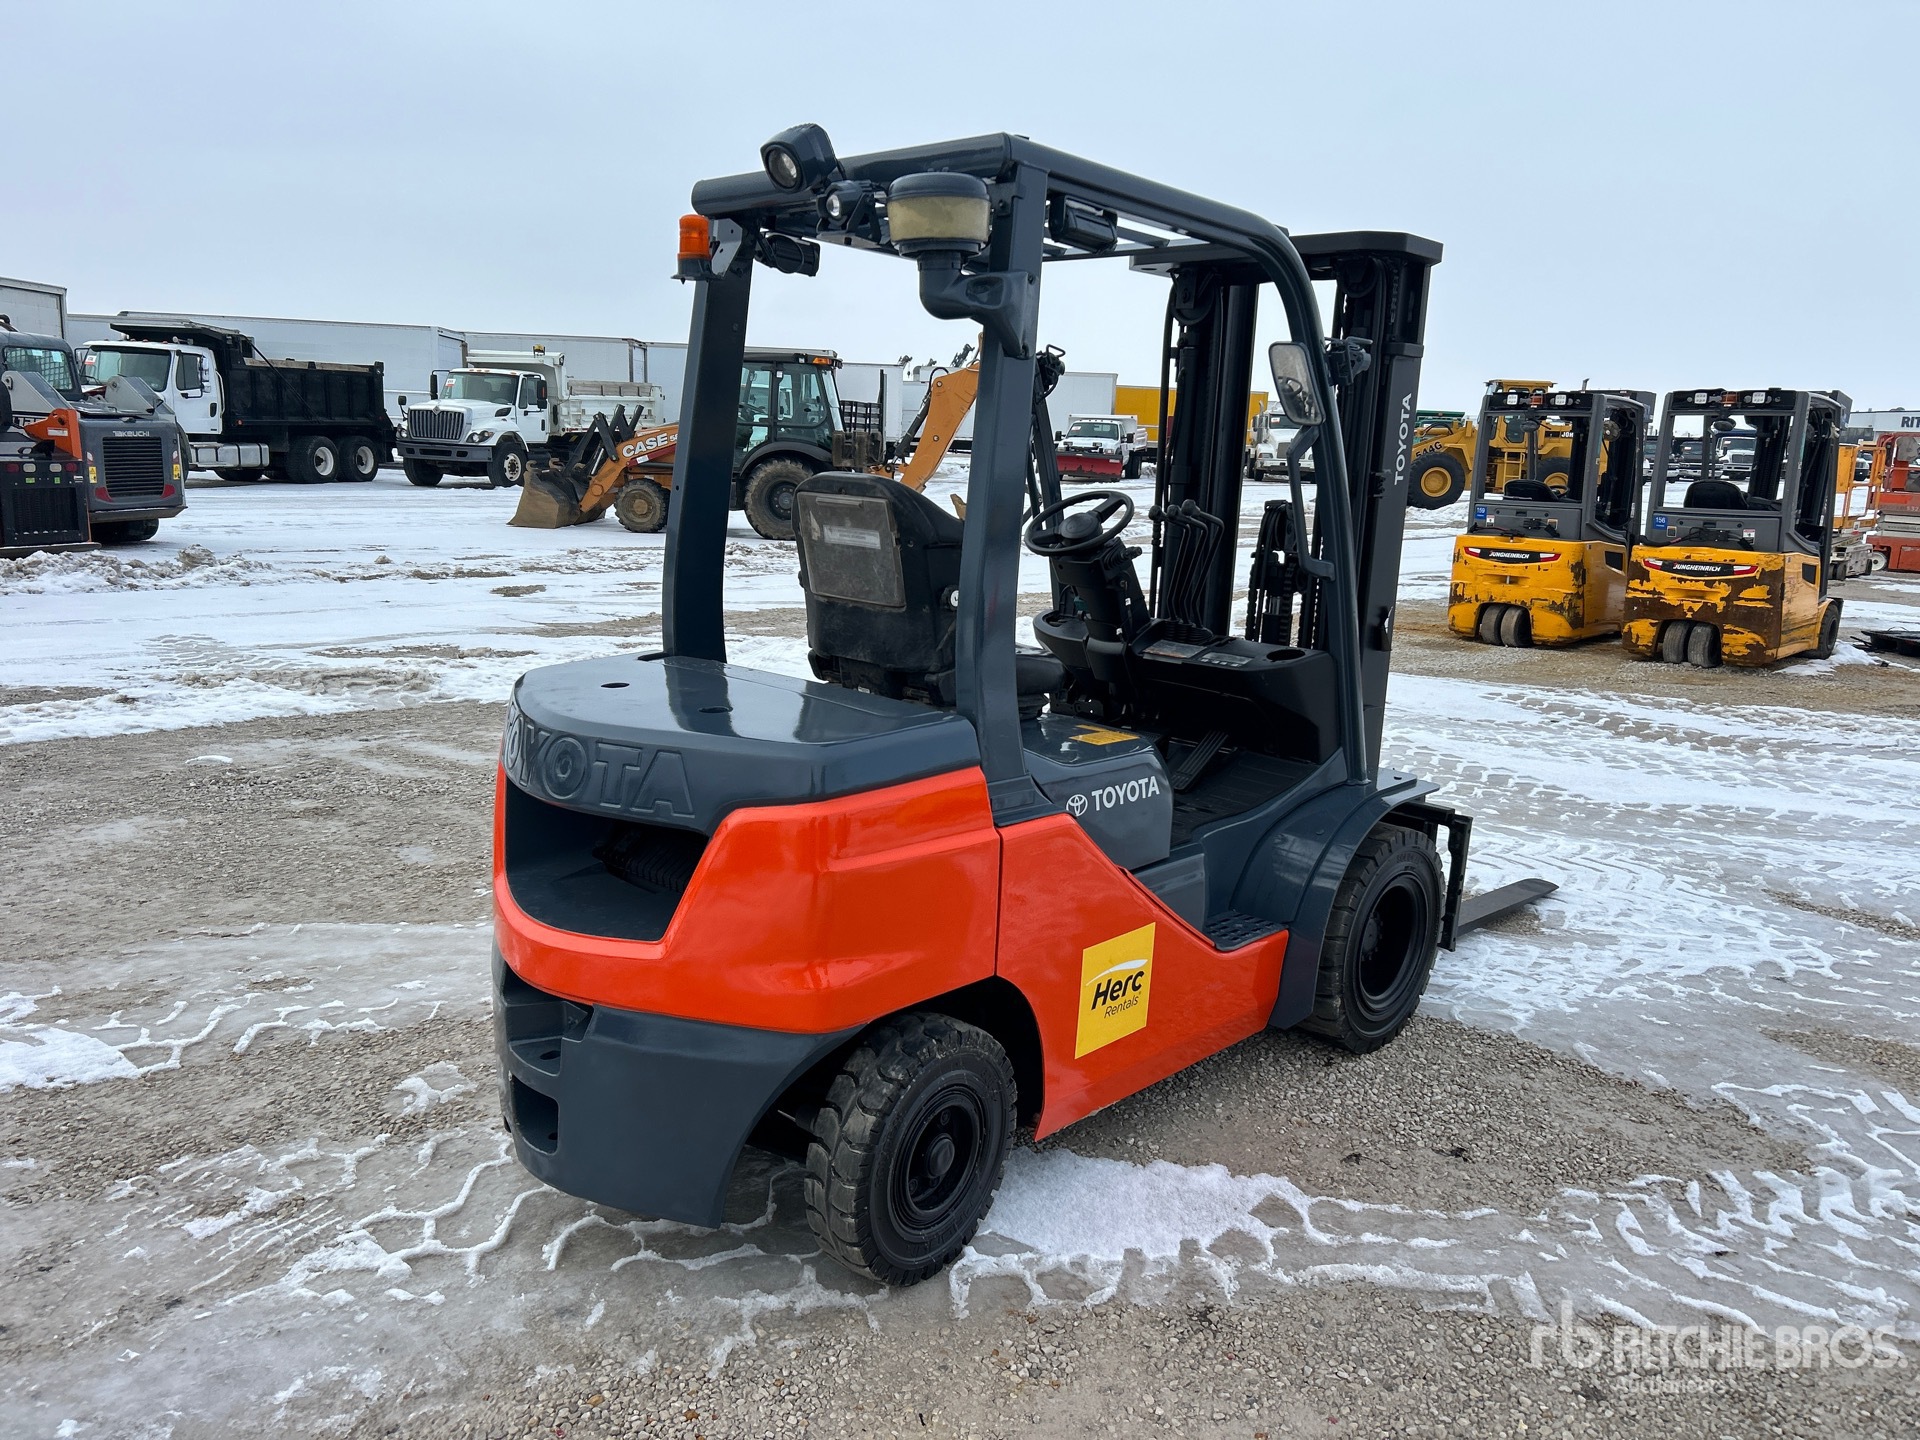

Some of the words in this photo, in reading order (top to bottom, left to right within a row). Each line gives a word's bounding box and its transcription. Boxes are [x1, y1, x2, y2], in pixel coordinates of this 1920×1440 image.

[622, 432, 668, 458] CASE
[1394, 393, 1412, 485] TOYOTA
[1655, 516, 1666, 524] 156
[1489, 550, 1530, 559] JUNGHEINRICH
[1672, 563, 1722, 572] JUNGHEINRICH
[1091, 775, 1160, 811] TOYOTA
[1091, 970, 1145, 1011] Herc
[1104, 994, 1140, 1019] Rentals
